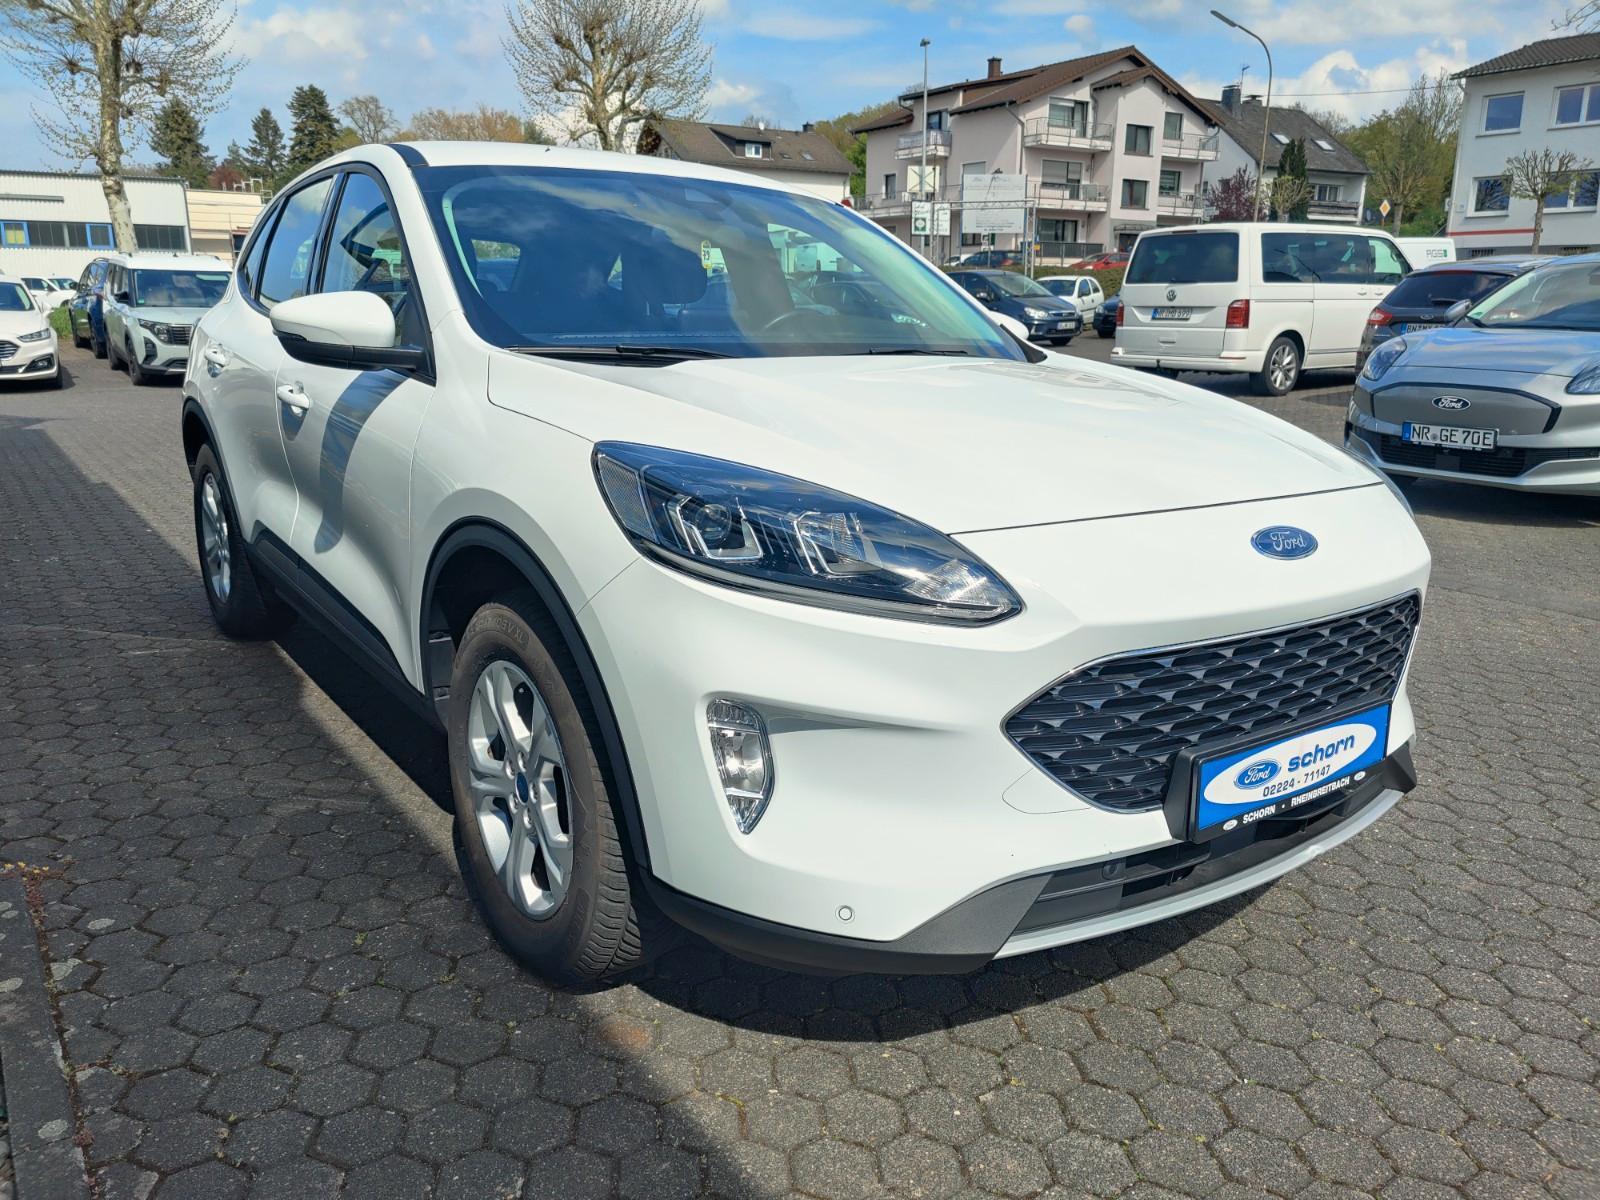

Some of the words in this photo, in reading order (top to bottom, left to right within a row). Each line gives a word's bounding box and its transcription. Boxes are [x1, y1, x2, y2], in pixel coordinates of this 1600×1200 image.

[1438, 397, 1463, 409] Ford
[1411, 425, 1431, 441] NR
[1439, 428, 1459, 443] GE
[1462, 430, 1493, 447] 70E
[1270, 530, 1307, 551] Ford
[1244, 764, 1272, 784] Ford
[1287, 734, 1355, 773] schorn
[1262, 778, 1295, 797] 02224
[1303, 765, 1331, 783] 71147
[1242, 804, 1276, 824] SCHORN
